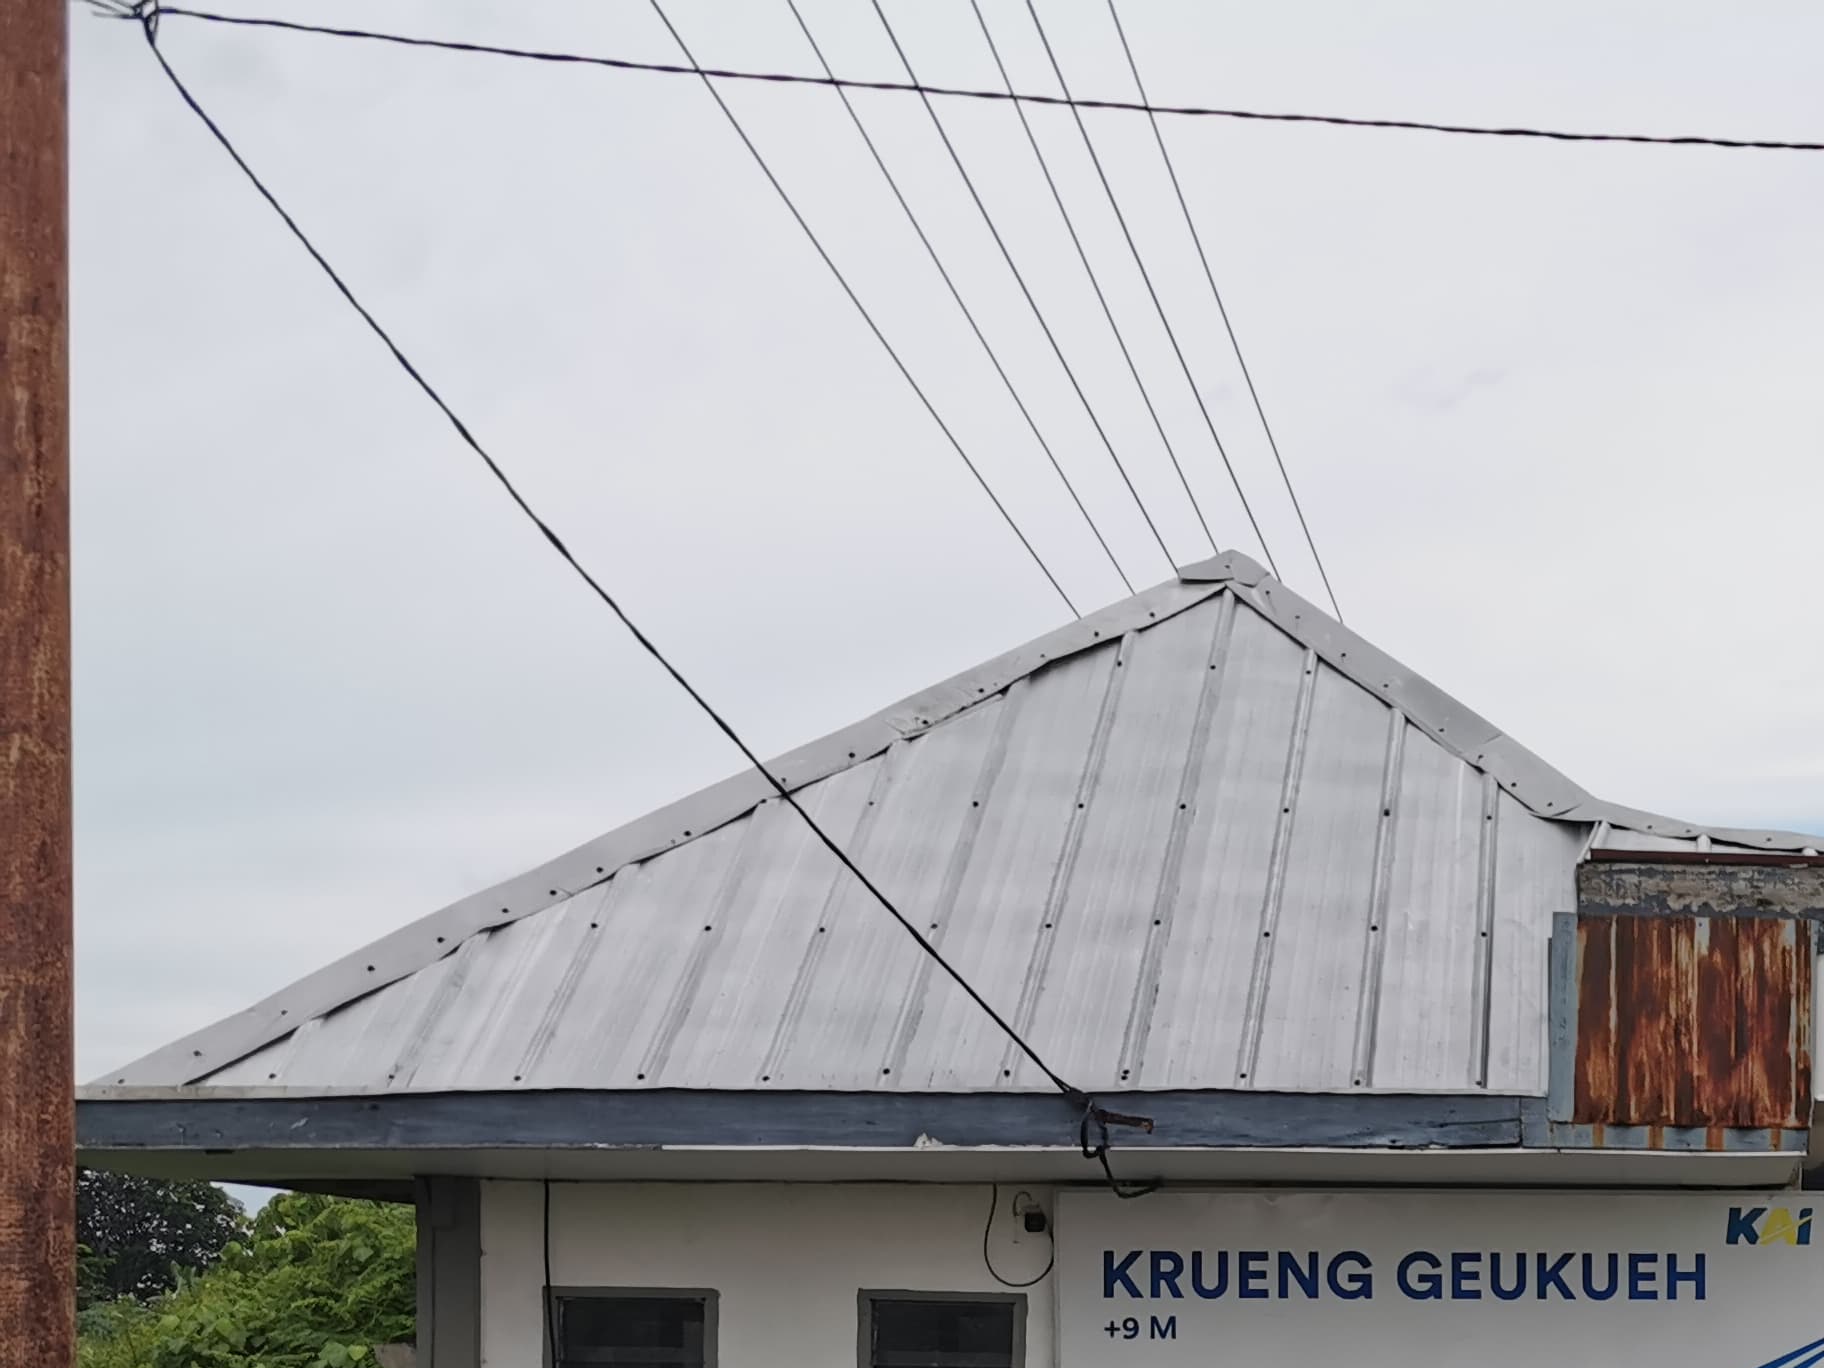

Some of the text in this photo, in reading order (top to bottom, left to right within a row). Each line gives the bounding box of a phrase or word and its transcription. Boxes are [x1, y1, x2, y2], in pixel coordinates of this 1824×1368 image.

[1103, 1250, 1706, 1300] KRUENG GEUKUEH
[1104, 1316, 1176, 1339] +9 M
